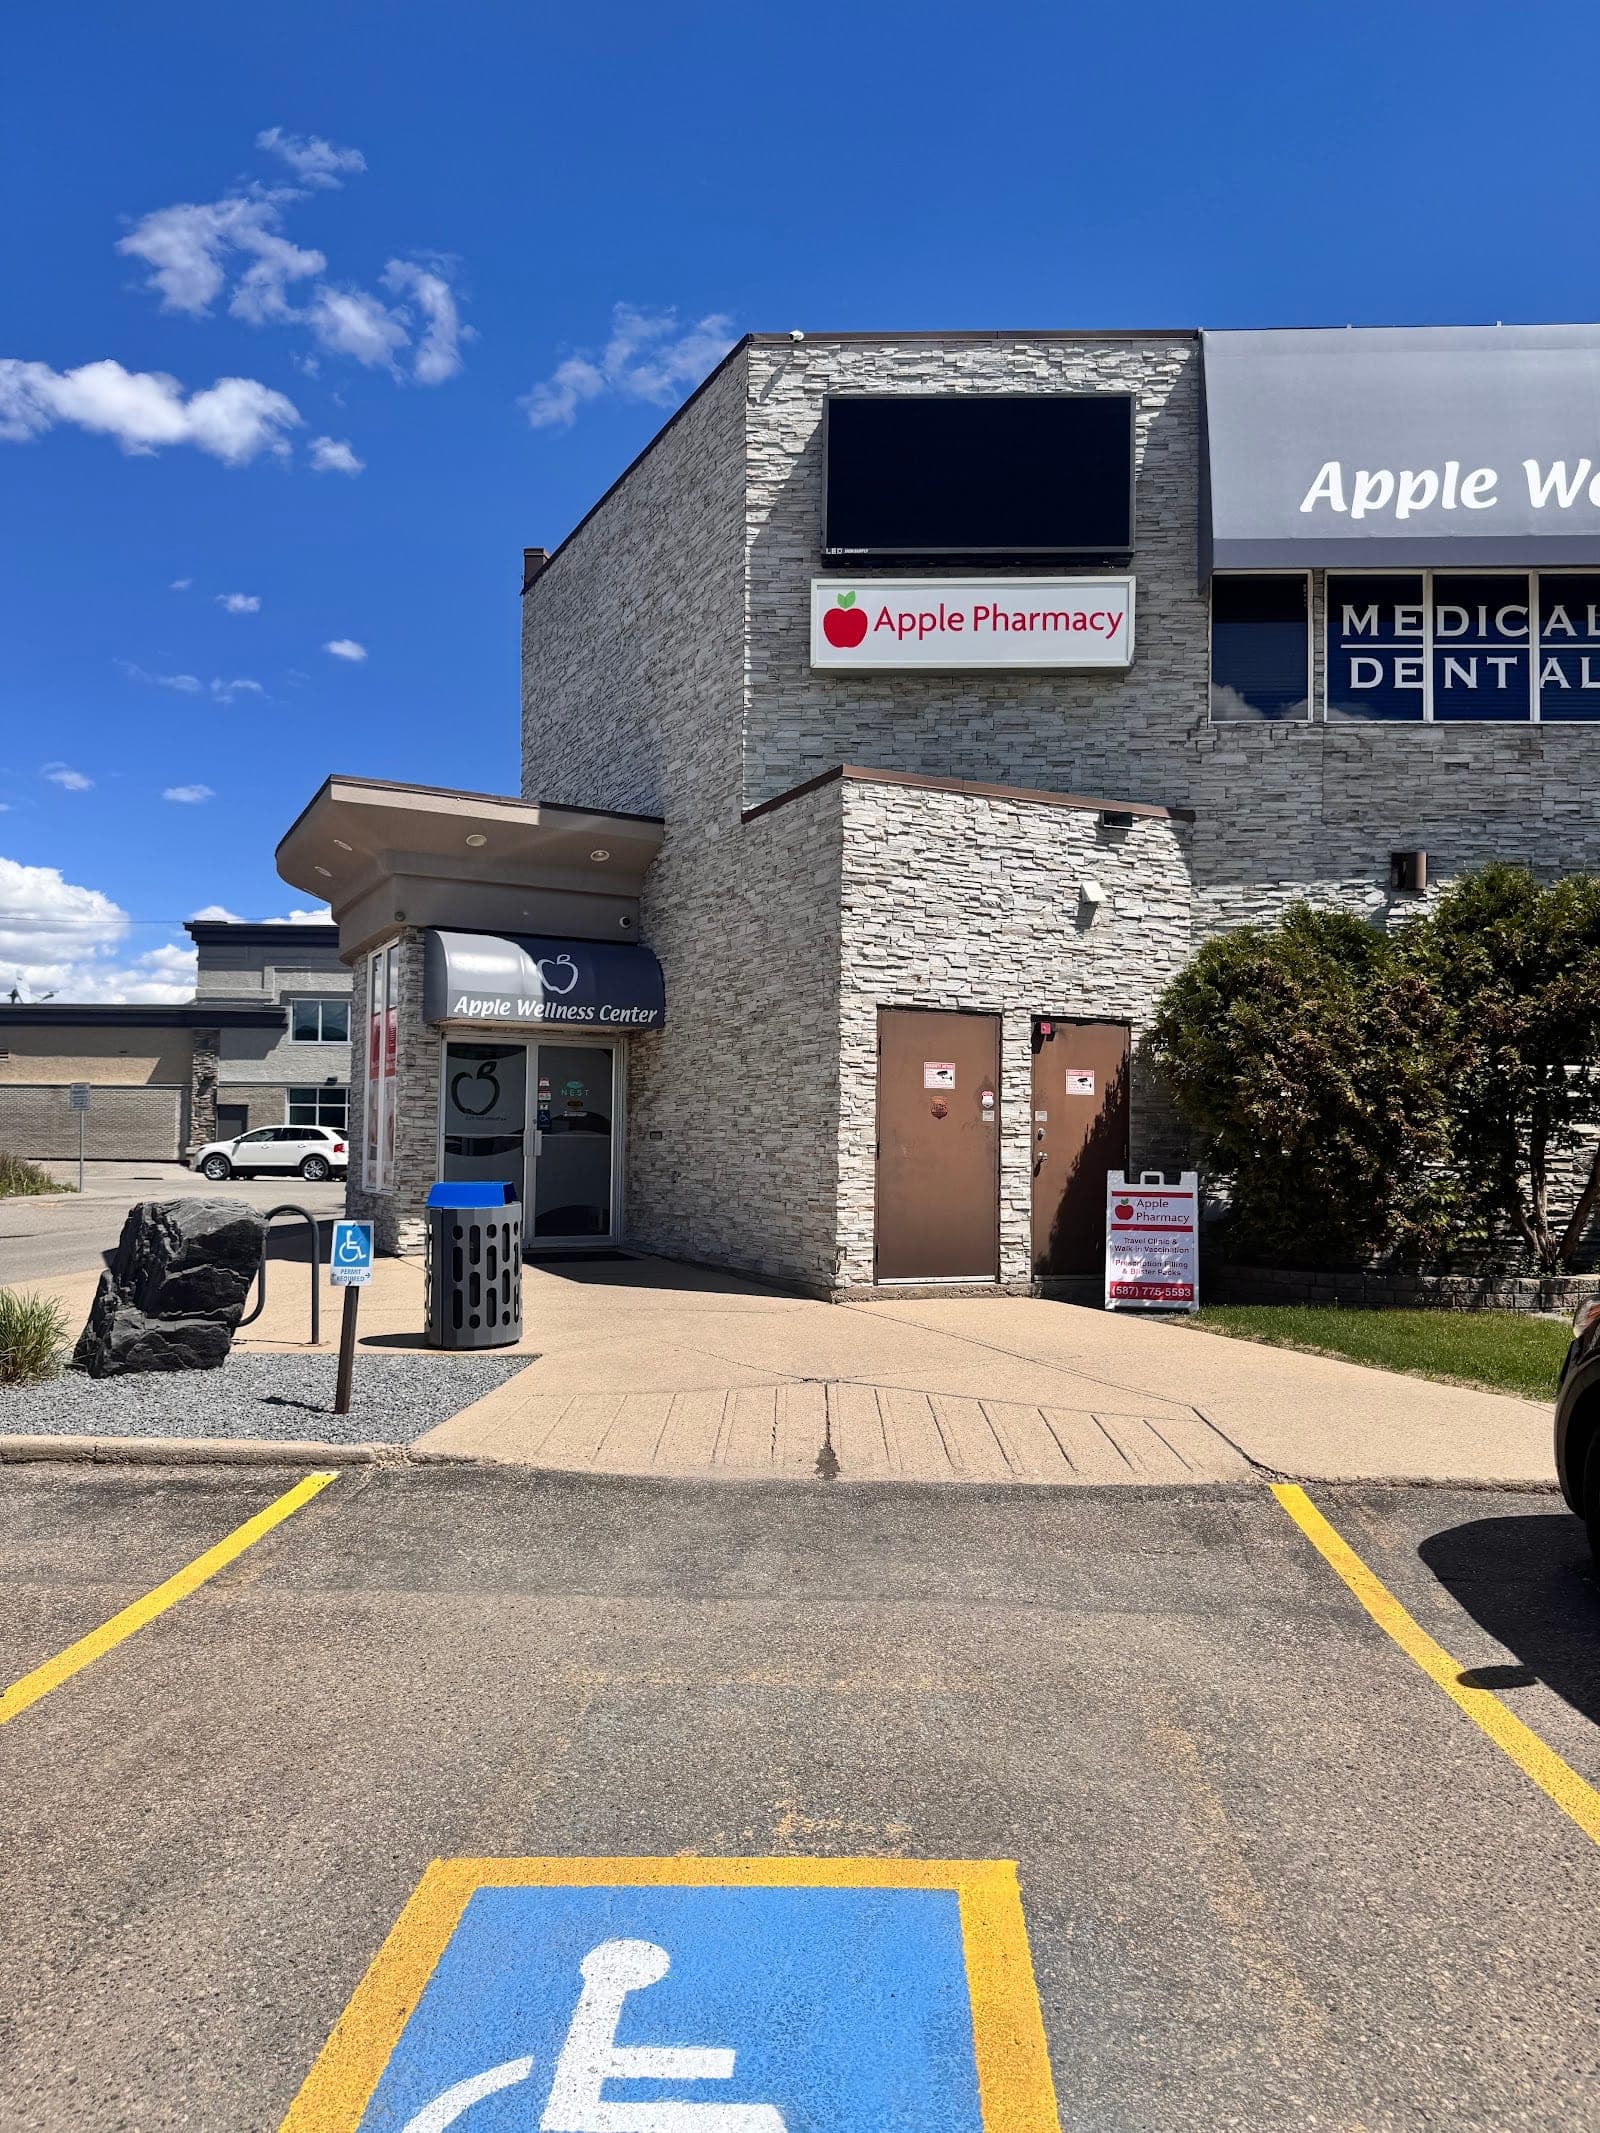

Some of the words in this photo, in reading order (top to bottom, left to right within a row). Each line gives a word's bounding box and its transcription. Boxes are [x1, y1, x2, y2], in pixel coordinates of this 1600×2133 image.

[1300, 461, 1498, 519] Apple
[874, 603, 964, 640] Apple
[973, 603, 1123, 639] Pharmacy
[1341, 604, 1600, 637] MEDICAL
[1349, 656, 1600, 689] DENTAL
[454, 996, 511, 1018] Apple
[517, 999, 595, 1021] Wellness
[599, 1005, 658, 1024] Center
[561, 1088, 590, 1096] NEST
[1136, 1198, 1169, 1210] Apple
[1136, 1212, 1190, 1225] Pharmacy
[1124, 1237, 1146, 1245] Travel
[1147, 1238, 1171, 1246] Clinic
[1144, 1246, 1190, 1254] Vaccination
[1130, 1268, 1156, 1276] Blister
[1111, 1285, 1139, 1297] (587)
[1141, 1286, 1192, 1298] 775-5593
